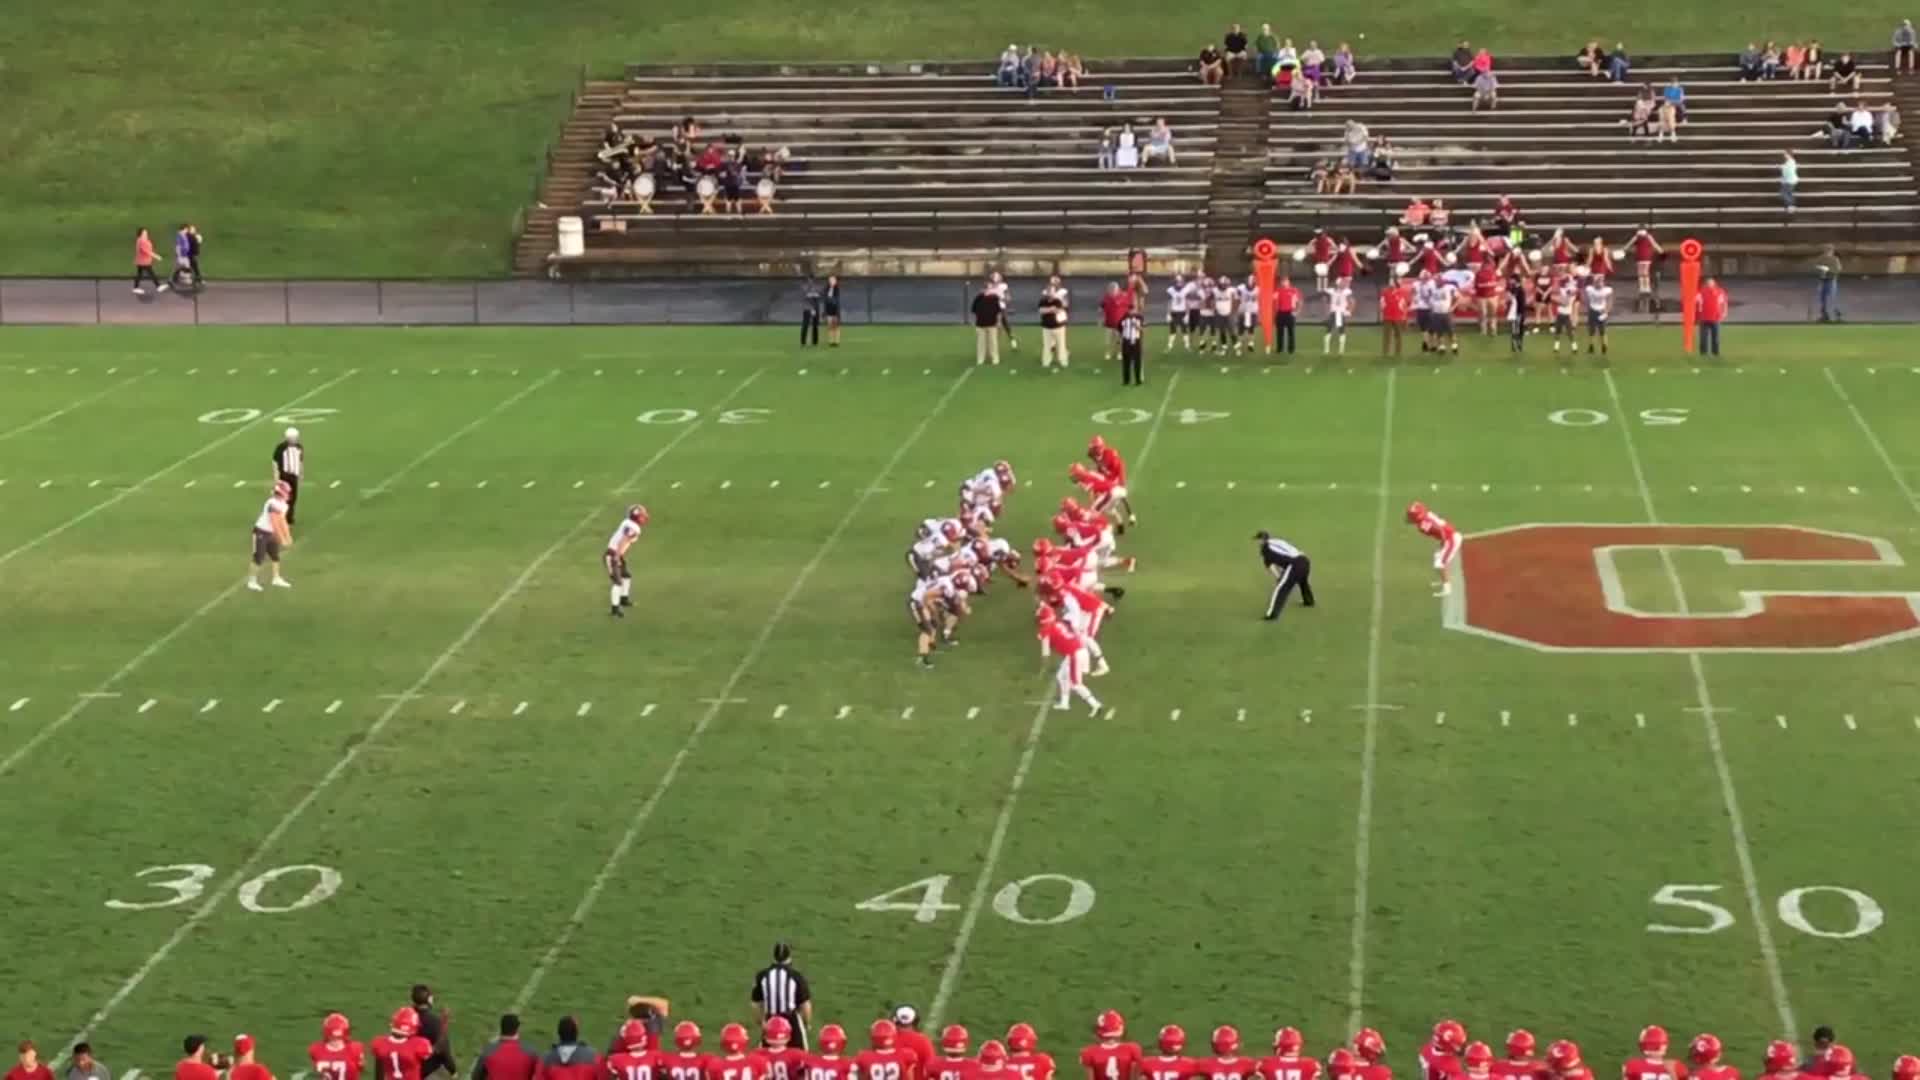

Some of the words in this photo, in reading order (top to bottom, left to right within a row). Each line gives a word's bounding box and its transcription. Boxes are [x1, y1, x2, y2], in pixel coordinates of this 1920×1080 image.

[196, 408, 341, 424] 20
[636, 408, 776, 424] 30
[1091, 408, 1231, 424] 40
[1548, 408, 1690, 426] 50
[1442, 523, 1920, 653] C
[104, 864, 343, 913] 30
[855, 873, 1096, 924] 40
[1646, 884, 1884, 938] 50
[390, 1051, 403, 1078] 1
